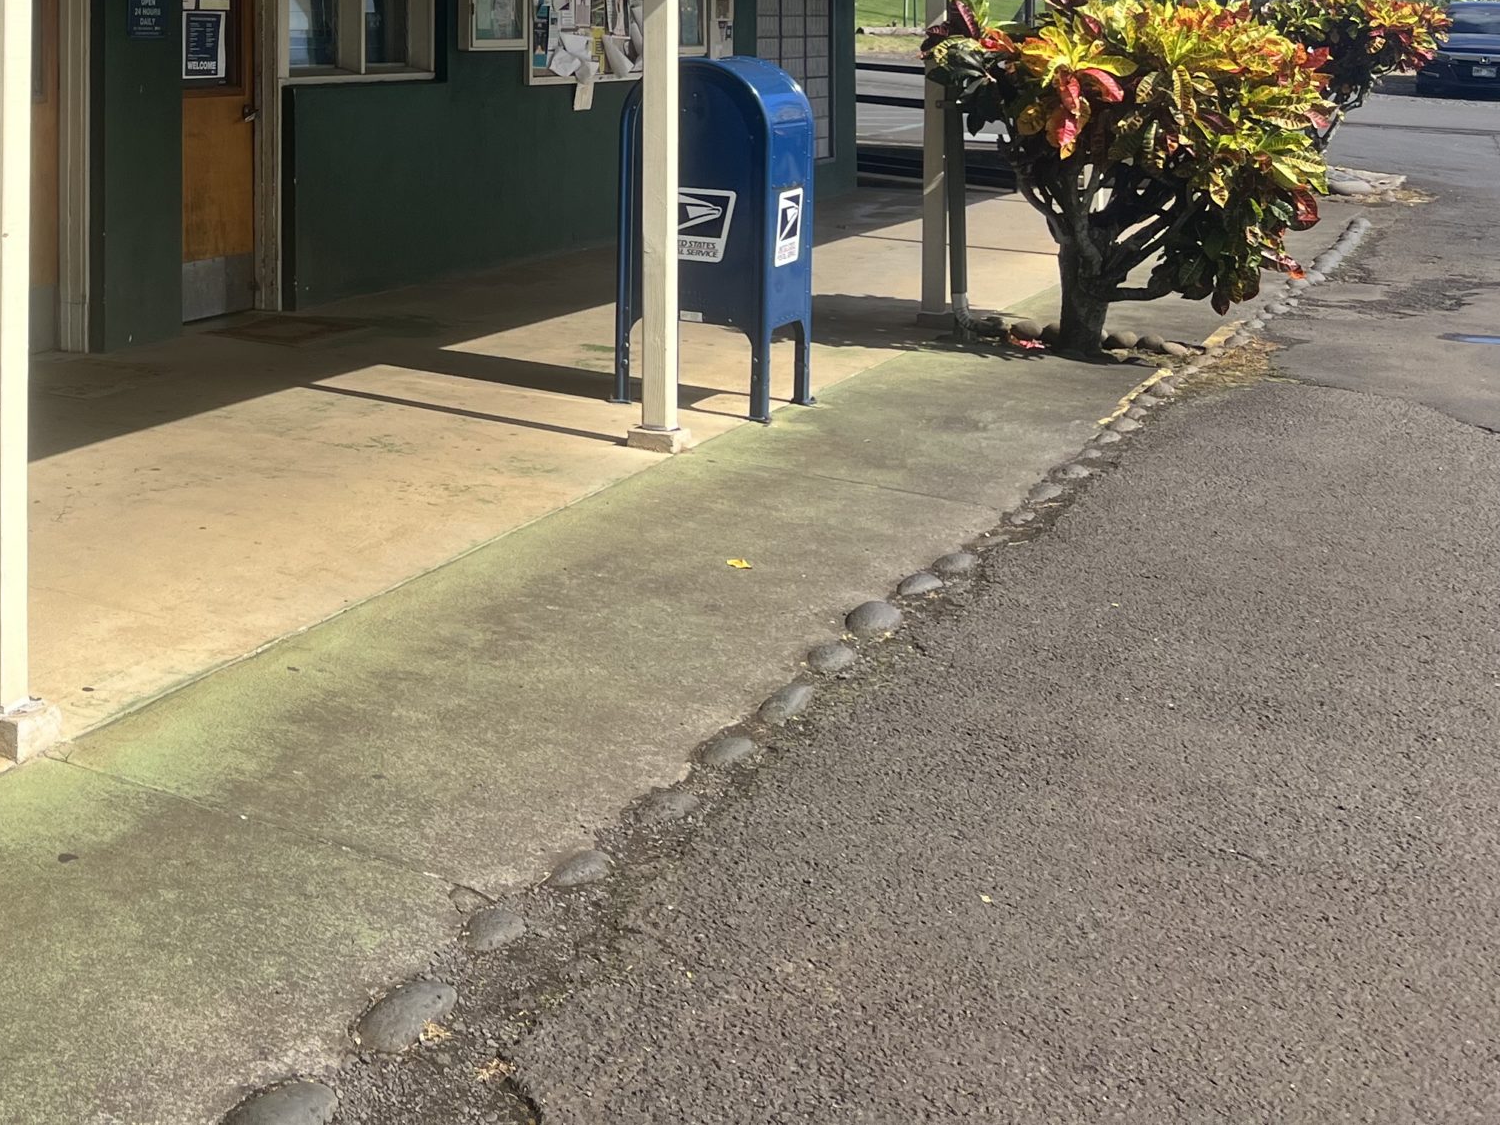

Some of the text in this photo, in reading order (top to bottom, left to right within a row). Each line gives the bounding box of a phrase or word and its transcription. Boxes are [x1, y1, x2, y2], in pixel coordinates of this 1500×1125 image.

[142, 7, 161, 16] HOURS
[139, 17, 156, 26] DAILY
[187, 60, 216, 71] WELCOME
[688, 240, 716, 249] STATES
[686, 248, 718, 258] SERVICE
